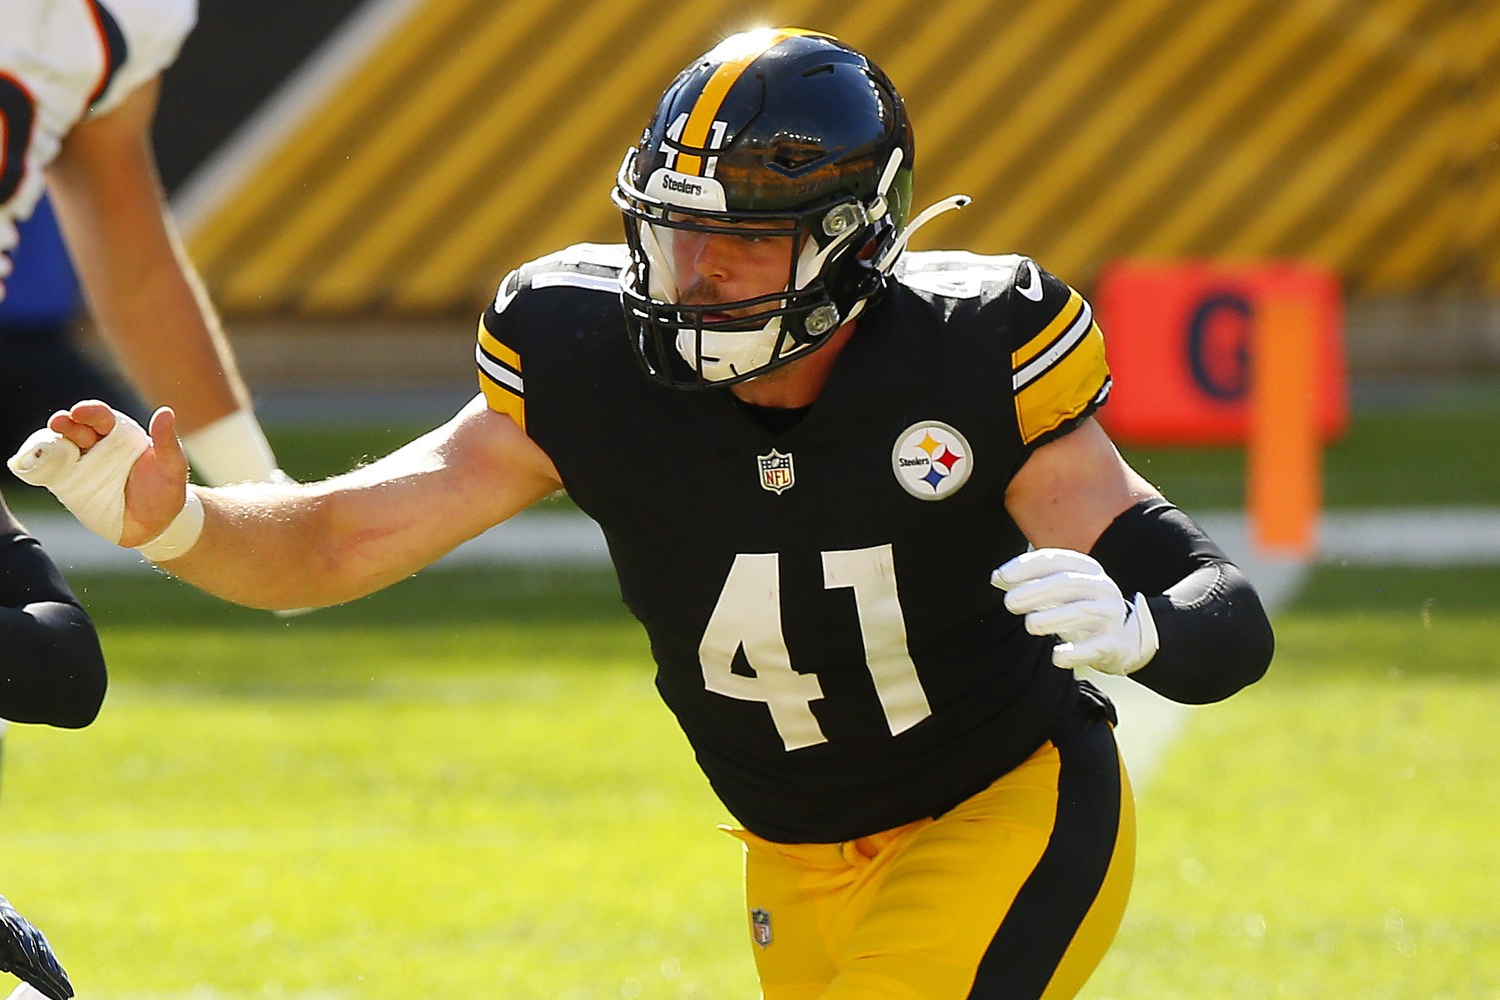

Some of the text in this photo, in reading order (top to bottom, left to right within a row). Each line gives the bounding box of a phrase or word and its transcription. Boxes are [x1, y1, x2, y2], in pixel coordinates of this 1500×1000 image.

[659, 112, 728, 178] 41
[662, 174, 702, 196] Steelers
[1186, 291, 1254, 405] G
[765, 470, 791, 487] NFL
[899, 457, 930, 468] Steelers
[697, 543, 932, 752] 41
